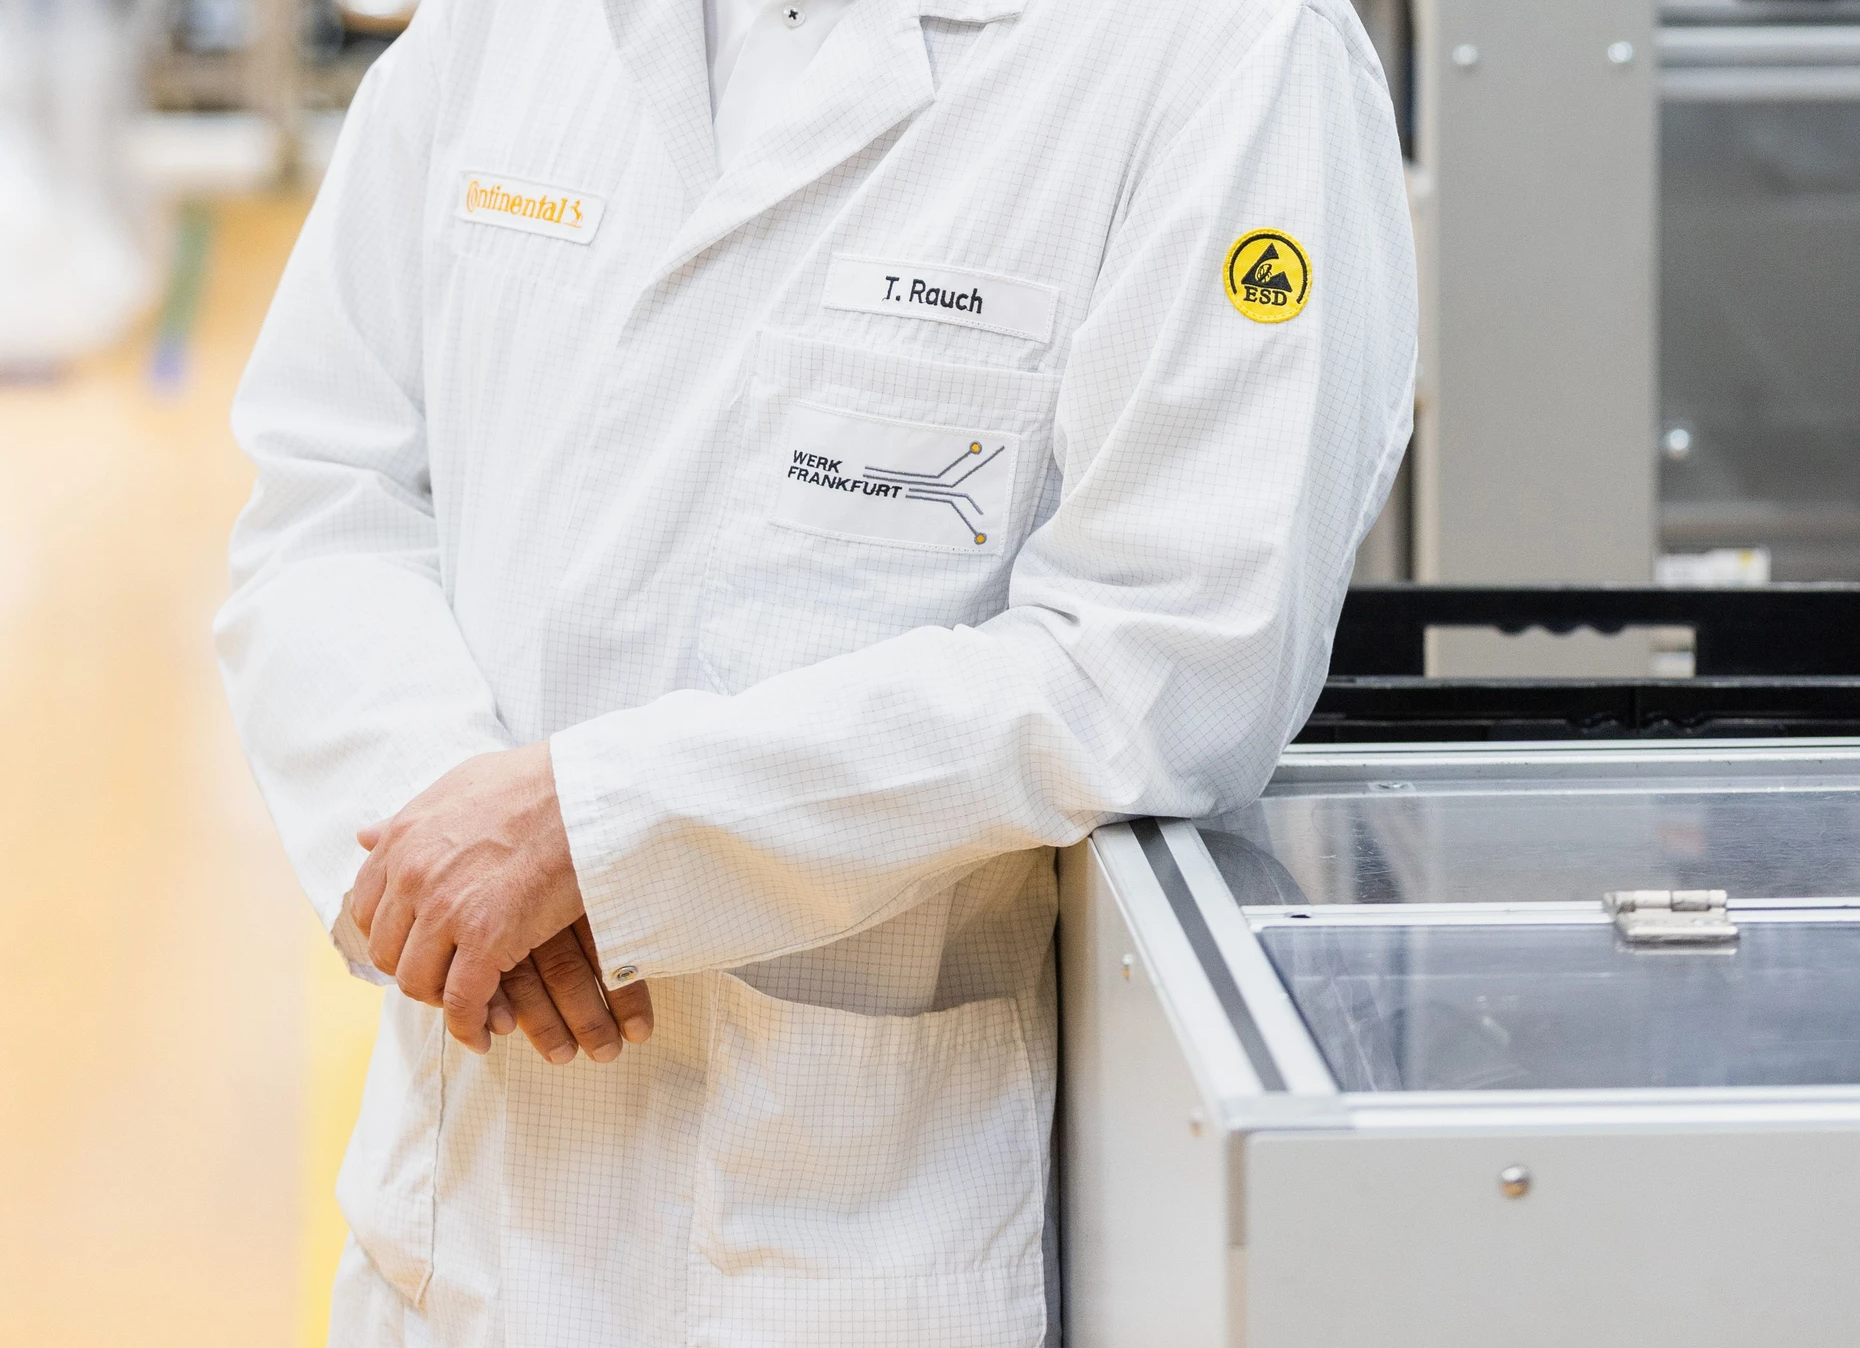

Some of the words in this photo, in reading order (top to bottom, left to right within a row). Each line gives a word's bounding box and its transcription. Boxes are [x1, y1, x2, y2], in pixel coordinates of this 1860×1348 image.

[466, 179, 569, 224] Continental
[883, 275, 901, 302] T.
[909, 278, 984, 314] Rauch
[1243, 285, 1288, 307] ESD
[792, 449, 843, 474] WERK
[787, 465, 903, 499] FRANKFURT
